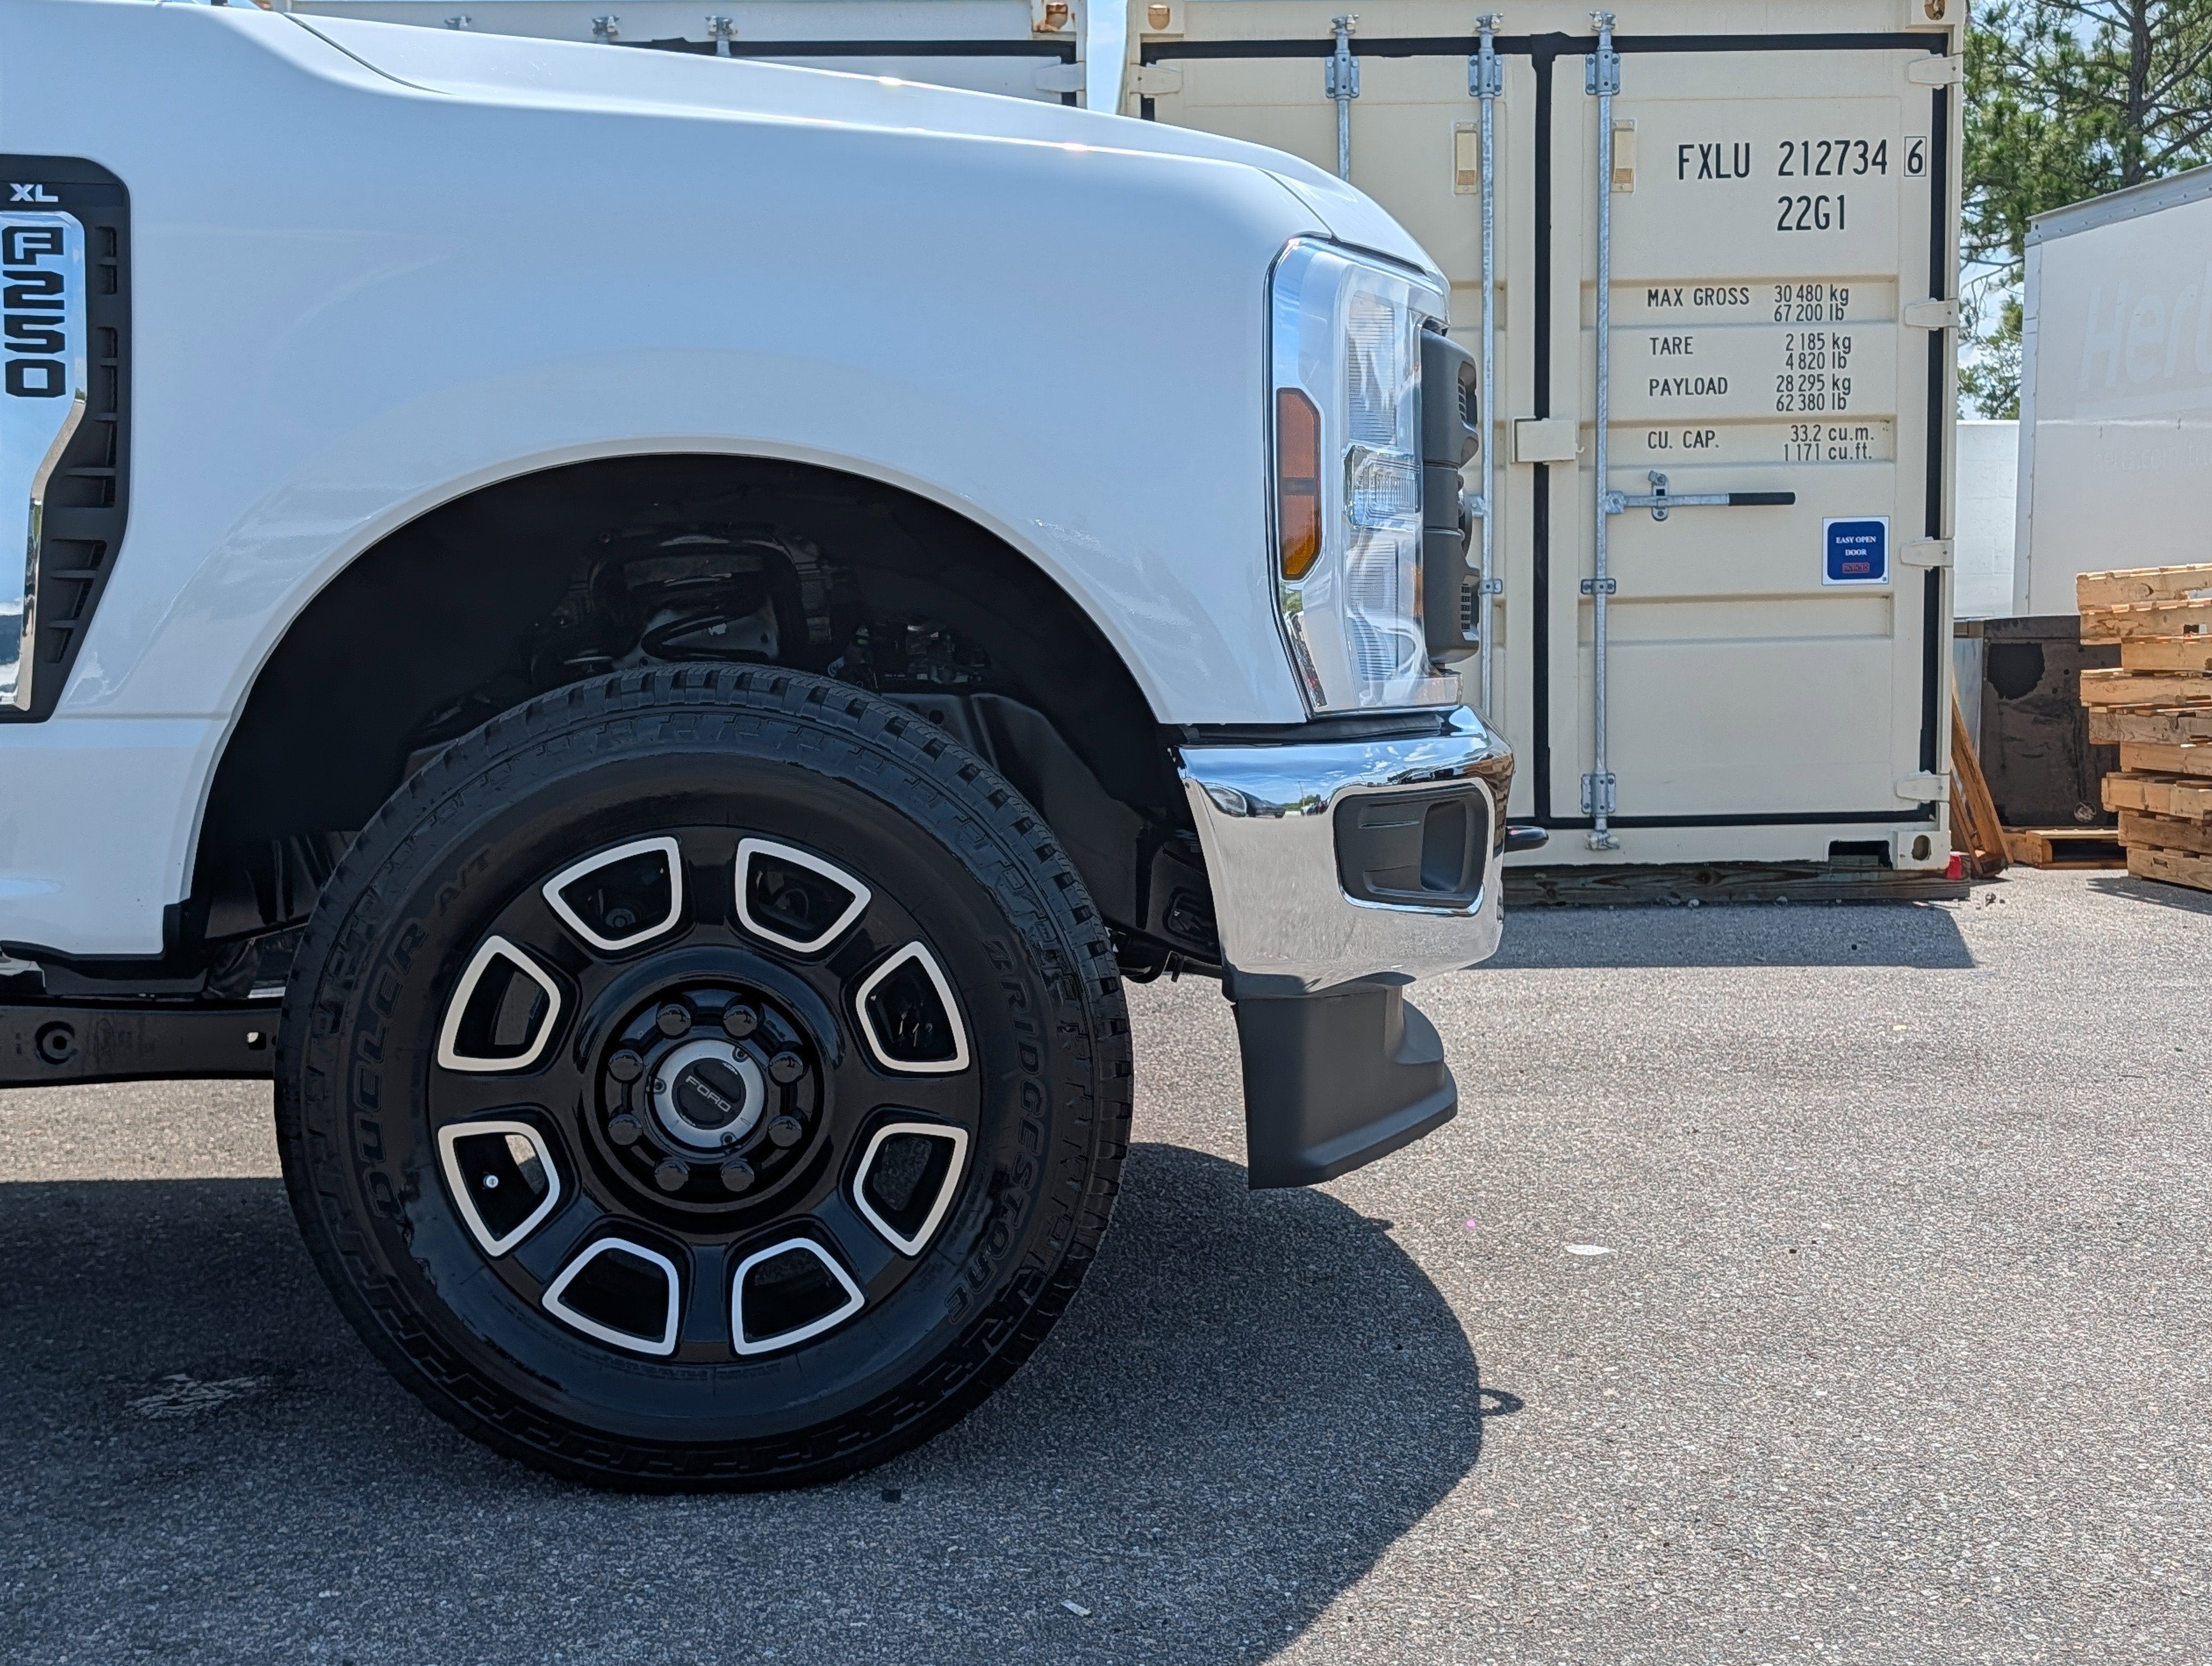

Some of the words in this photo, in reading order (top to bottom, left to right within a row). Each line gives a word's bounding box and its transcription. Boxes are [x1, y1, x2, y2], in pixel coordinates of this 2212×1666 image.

[1679, 142, 1751, 181] FXLU
[1778, 139, 1888, 176] 212734
[1907, 139, 1924, 174] 6
[10, 183, 59, 202] XL
[1777, 194, 1846, 231] 22G1
[1648, 288, 1683, 307] MAX
[1693, 287, 1750, 306] GROSS
[1830, 284, 1849, 307] kg
[1829, 303, 1844, 322] lb
[1649, 336, 1694, 356] TARE
[1832, 332, 1851, 355] kg
[1832, 351, 1847, 369] lb
[1649, 376, 1728, 396] PAYLOAD
[1832, 373, 1851, 396] kg
[1831, 392, 1847, 411] lb
[1648, 431, 1673, 449] CU.
[1683, 430, 1719, 448] CAP.
[1790, 424, 1821, 443] 33.2
[685, 1075, 732, 1112] FORD
